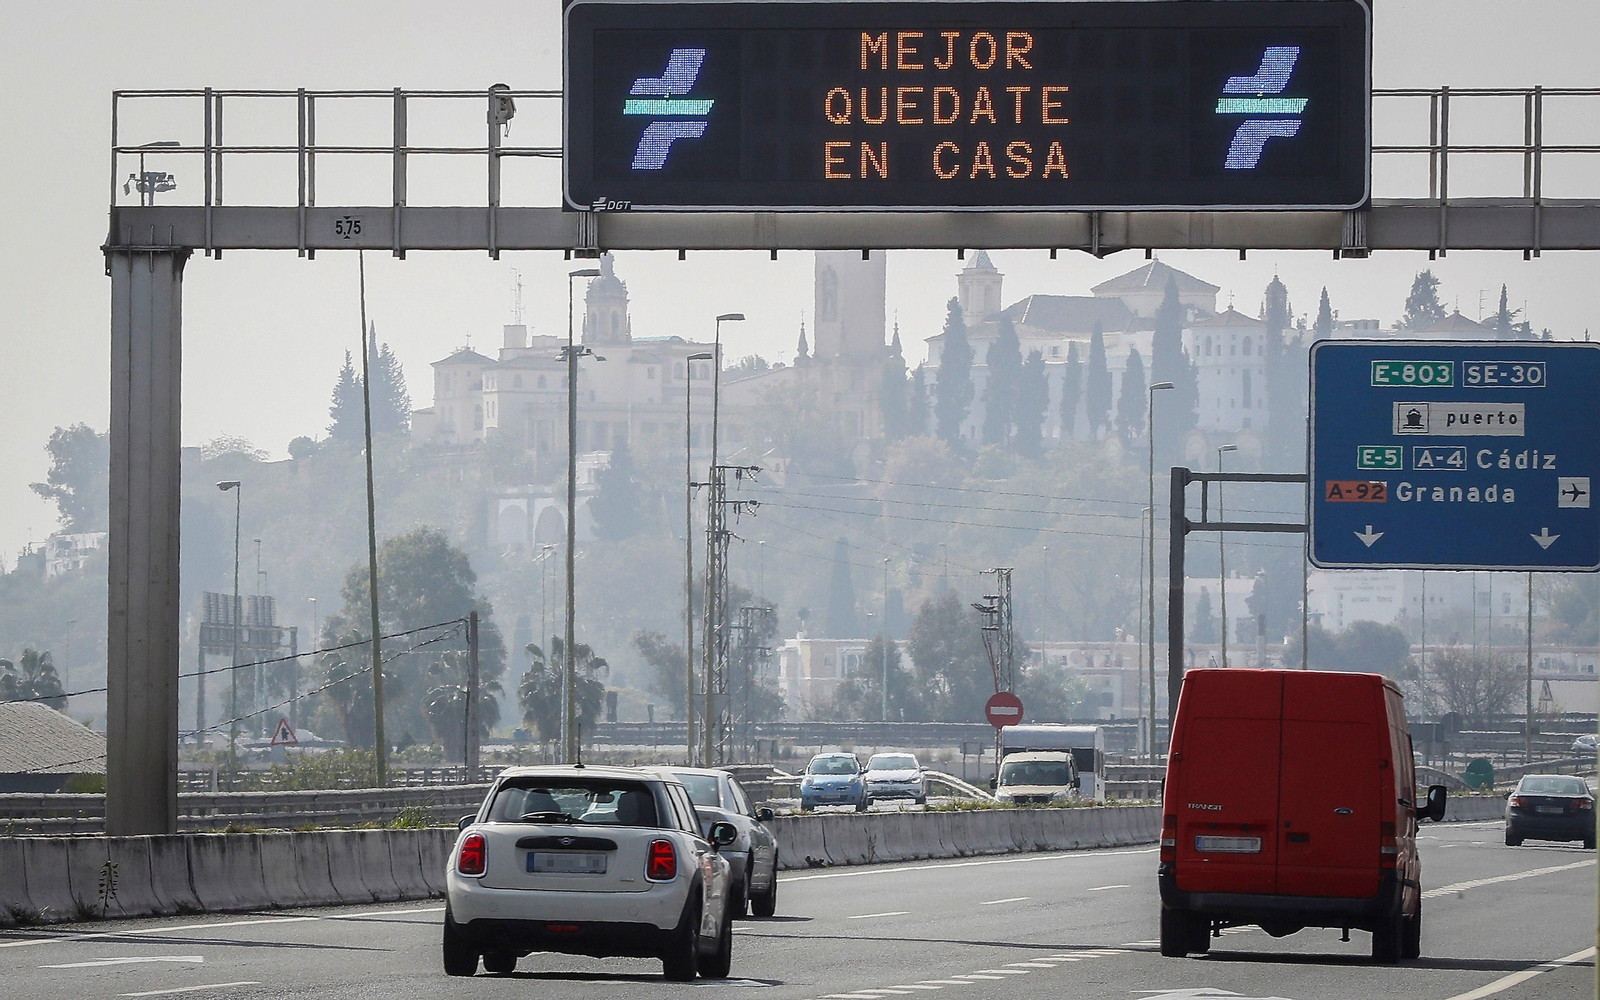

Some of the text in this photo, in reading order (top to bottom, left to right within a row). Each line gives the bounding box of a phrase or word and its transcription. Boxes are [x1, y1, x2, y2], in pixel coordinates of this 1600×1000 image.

[861, 31, 1034, 70] MEJOR
[824, 86, 1069, 126] QUEDATE
[824, 141, 1069, 180] EN CASA
[607, 200, 631, 210] DGT
[1375, 365, 1542, 384] E-803 SE-30
[1446, 410, 1518, 427] puerto
[1362, 448, 1556, 469] E-5 A-4 Cádiz
[1327, 482, 1515, 503] A-92 Granada
